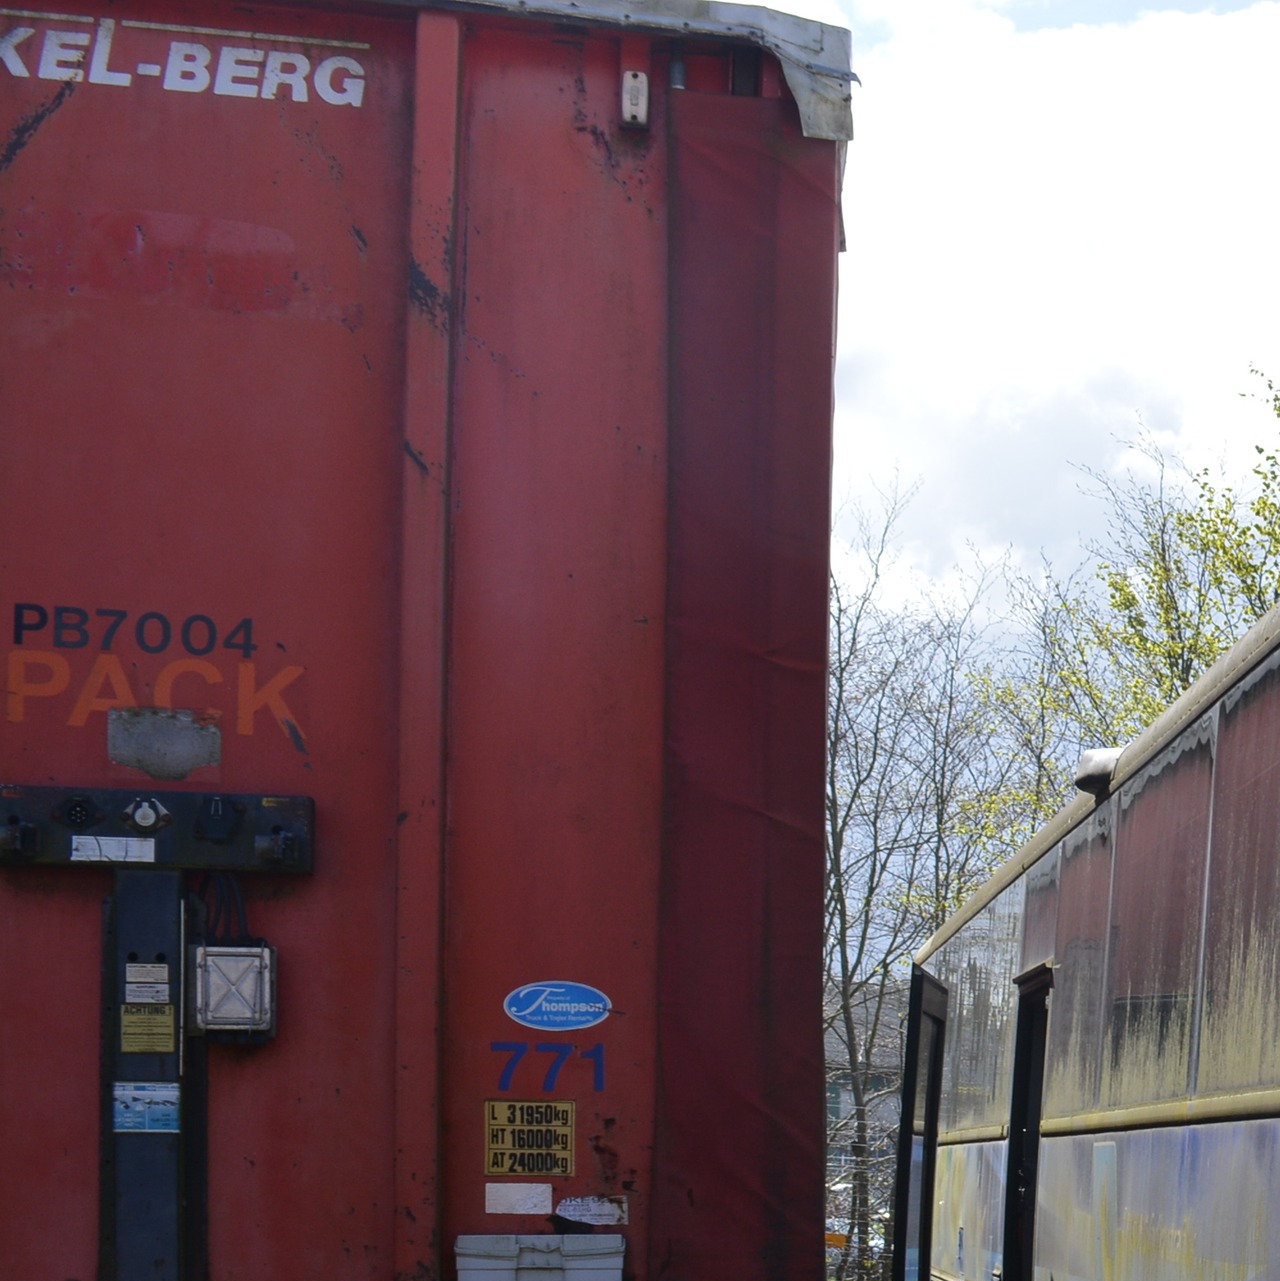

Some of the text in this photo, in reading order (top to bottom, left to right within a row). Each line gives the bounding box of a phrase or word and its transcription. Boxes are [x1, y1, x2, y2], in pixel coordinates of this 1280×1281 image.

[13, 603, 258, 659] PB7004
[6, 650, 307, 739] PACK
[510, 986, 604, 1015] Thompson
[490, 1042, 606, 1092] 771
[491, 1105, 498, 1121] L
[491, 1129, 506, 1145] HT
[491, 1152, 506, 1168] AT
